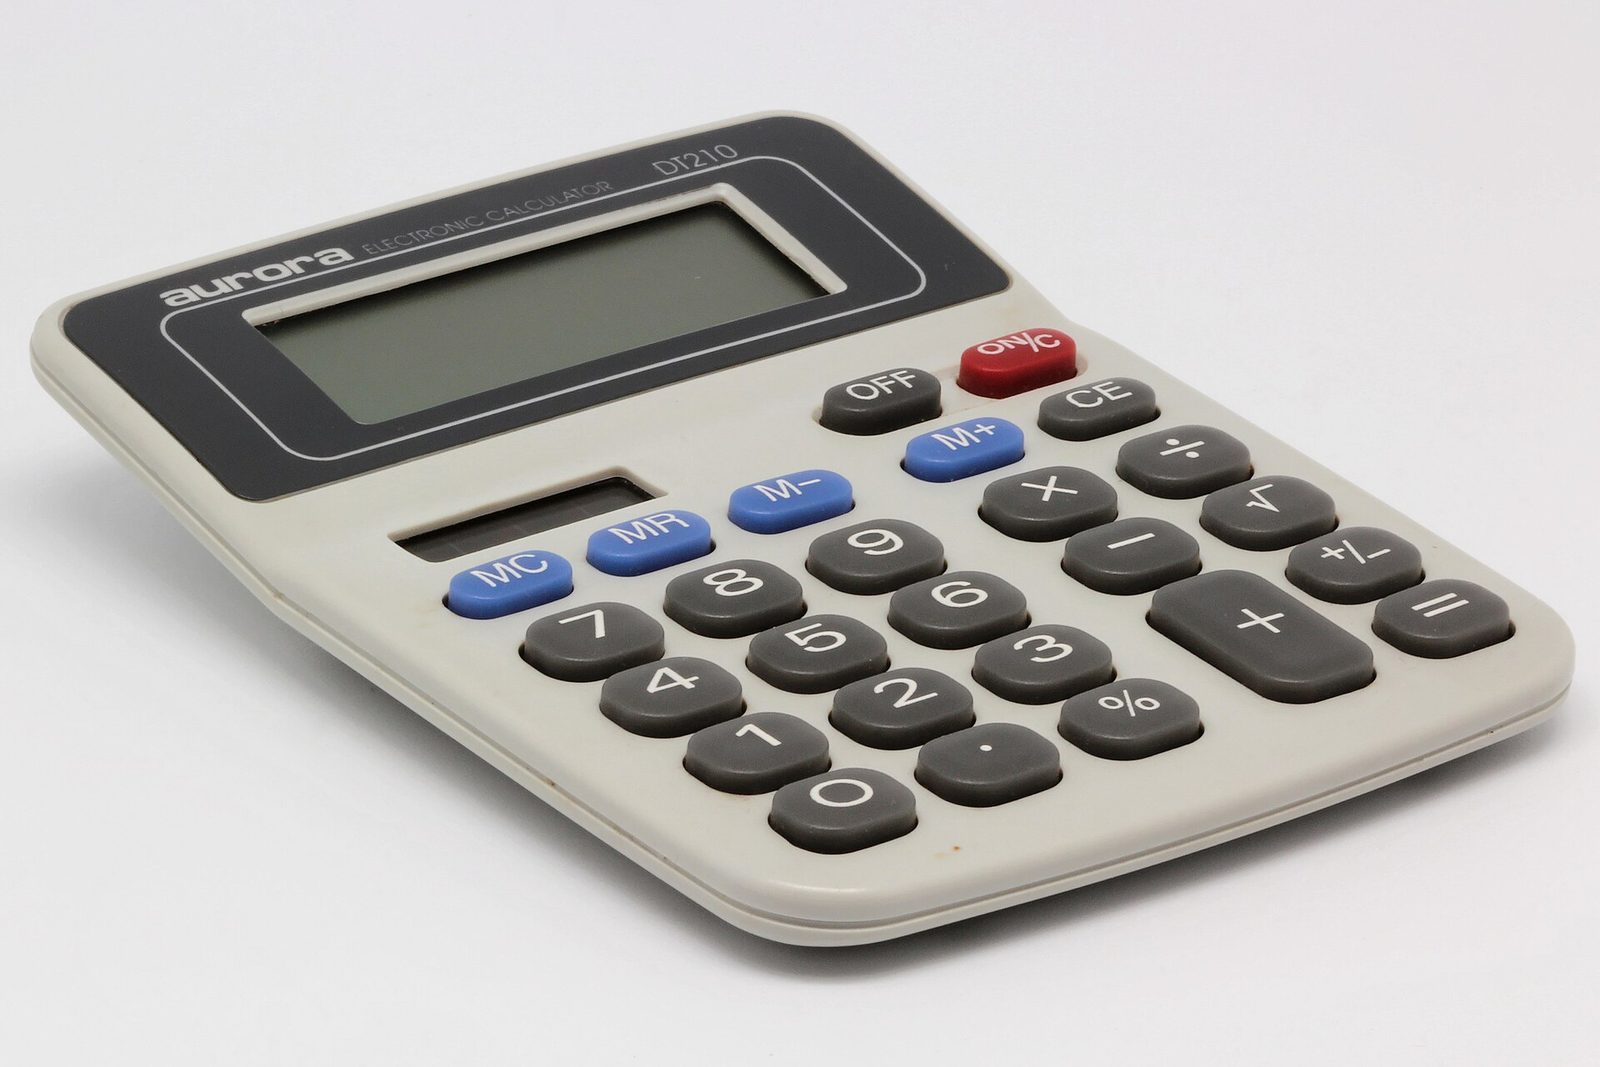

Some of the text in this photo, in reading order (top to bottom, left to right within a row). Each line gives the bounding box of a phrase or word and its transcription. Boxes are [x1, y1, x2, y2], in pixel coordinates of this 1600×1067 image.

[652, 143, 739, 177] DT210
[363, 180, 614, 256] ELECTRONIC CALCULATOR
[160, 245, 355, 308] aurora
[976, 330, 1062, 356] ON/C
[846, 368, 918, 400] OFF
[1066, 381, 1132, 408] CE
[931, 421, 997, 450] M+
[609, 513, 690, 545] MR
[846, 528, 904, 556] 9
[472, 551, 551, 588] MC
[702, 567, 764, 597] 8
[931, 580, 989, 608] 6
[558, 609, 607, 639] 7
[1236, 608, 1285, 634] +
[785, 622, 847, 653] 5
[1013, 634, 1074, 663] 3
[646, 666, 700, 694] 4
[873, 677, 939, 709] 2
[1097, 689, 1161, 717] %
[735, 723, 782, 747] 1
[809, 778, 874, 808] 0
